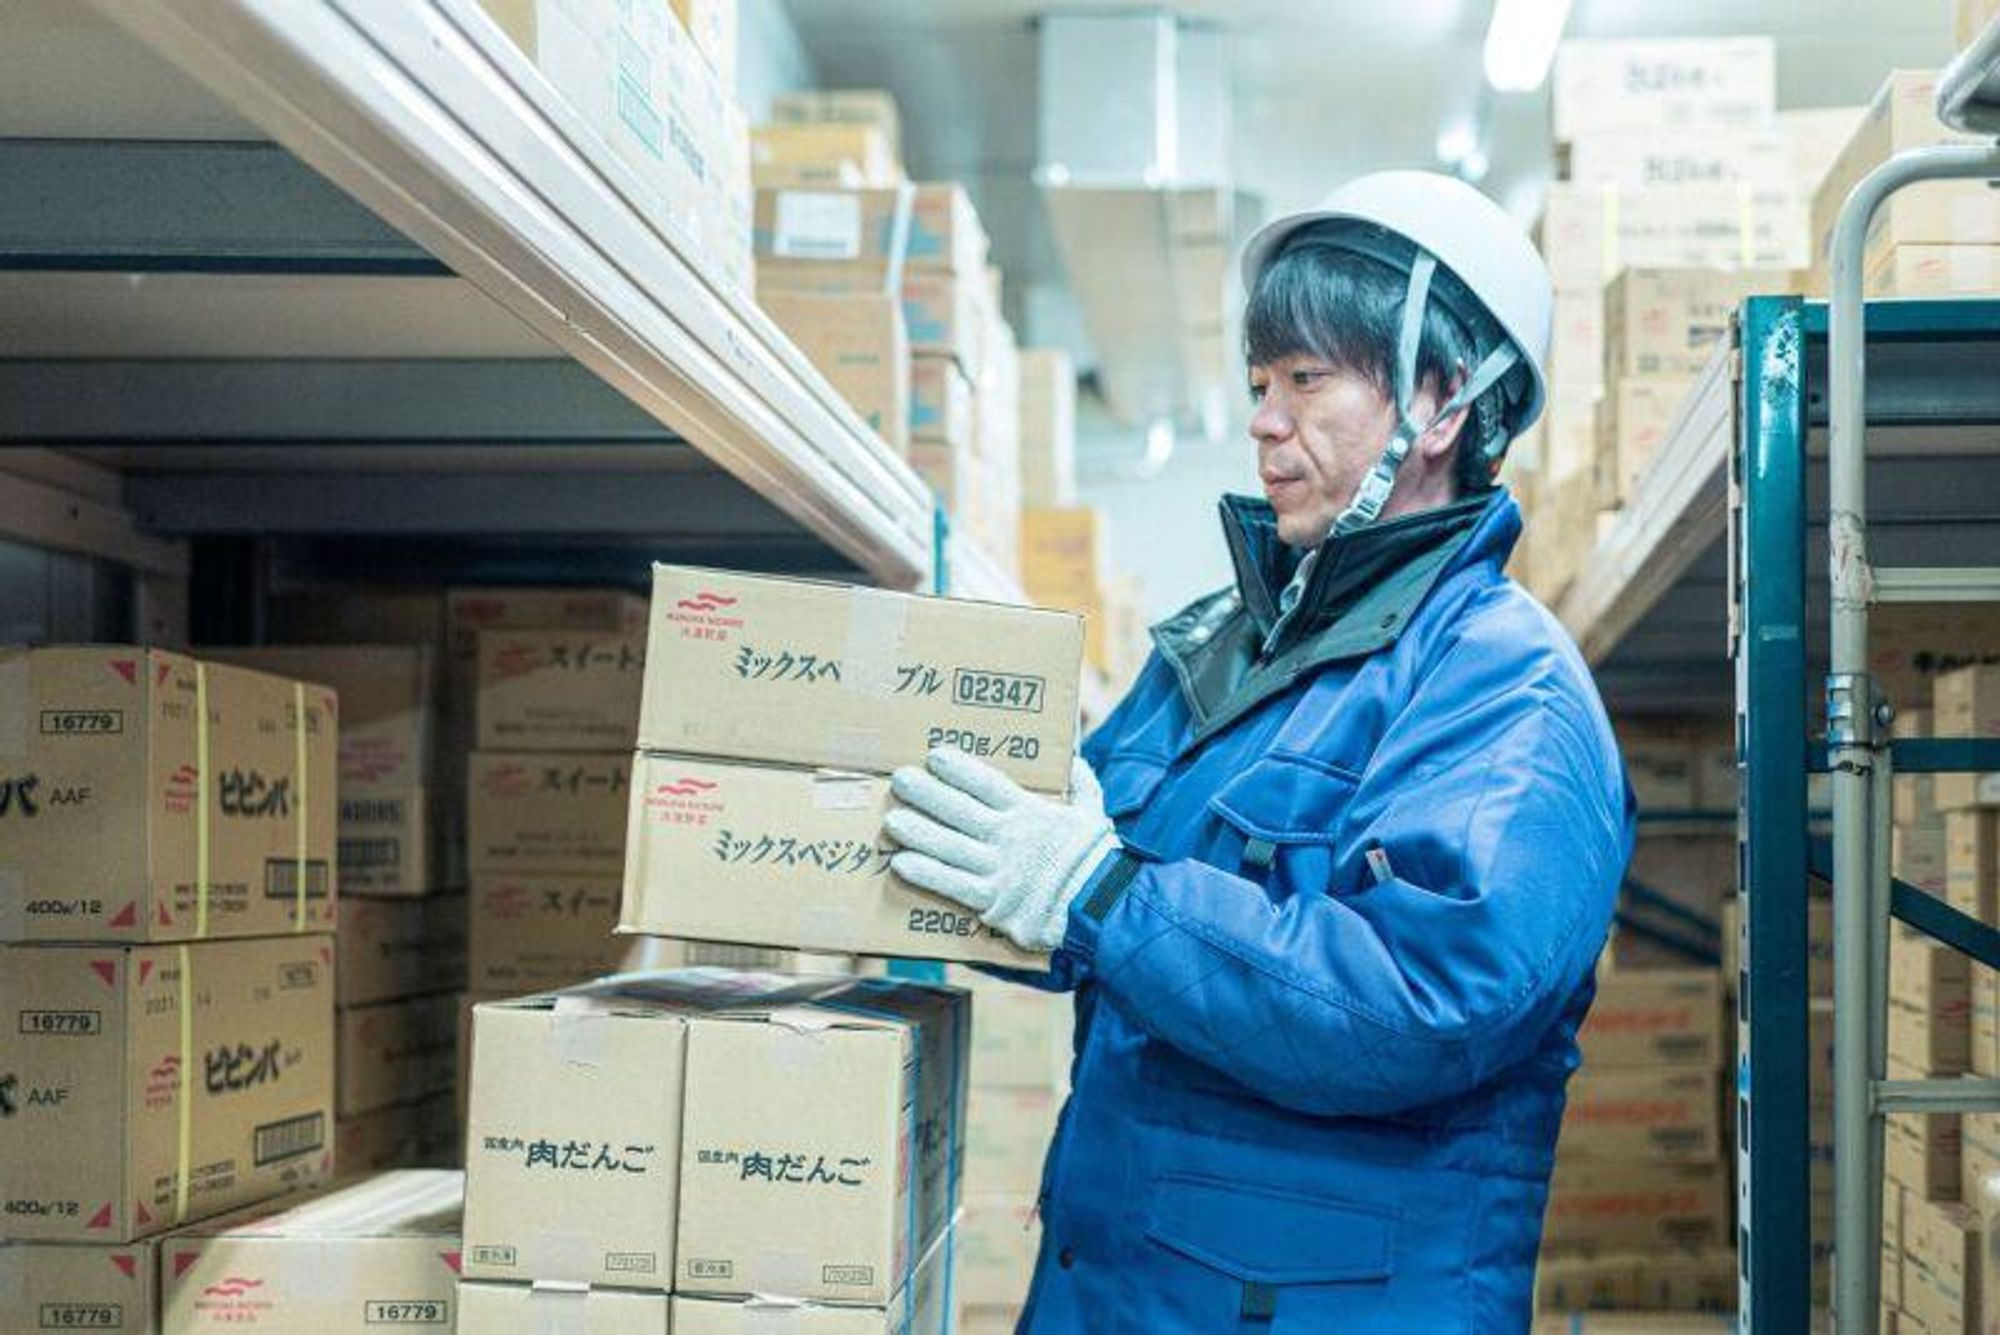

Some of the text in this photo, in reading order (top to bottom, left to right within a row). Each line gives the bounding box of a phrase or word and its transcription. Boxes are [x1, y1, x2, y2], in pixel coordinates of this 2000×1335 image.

[550, 643, 645, 671] スイート
[958, 673, 1040, 707] 02347
[53, 714, 115, 730] 16779
[926, 727, 1041, 760] 220g/20
[908, 907, 1008, 939] 220g/
[32, 1013, 93, 1030] 16779
[27, 1088, 70, 1106] AAF
[525, 1138, 654, 1173] 肉だんご
[740, 1150, 872, 1187] 肉だんご
[51, 1309, 112, 1325] 16779
[377, 1304, 437, 1320] 16779
